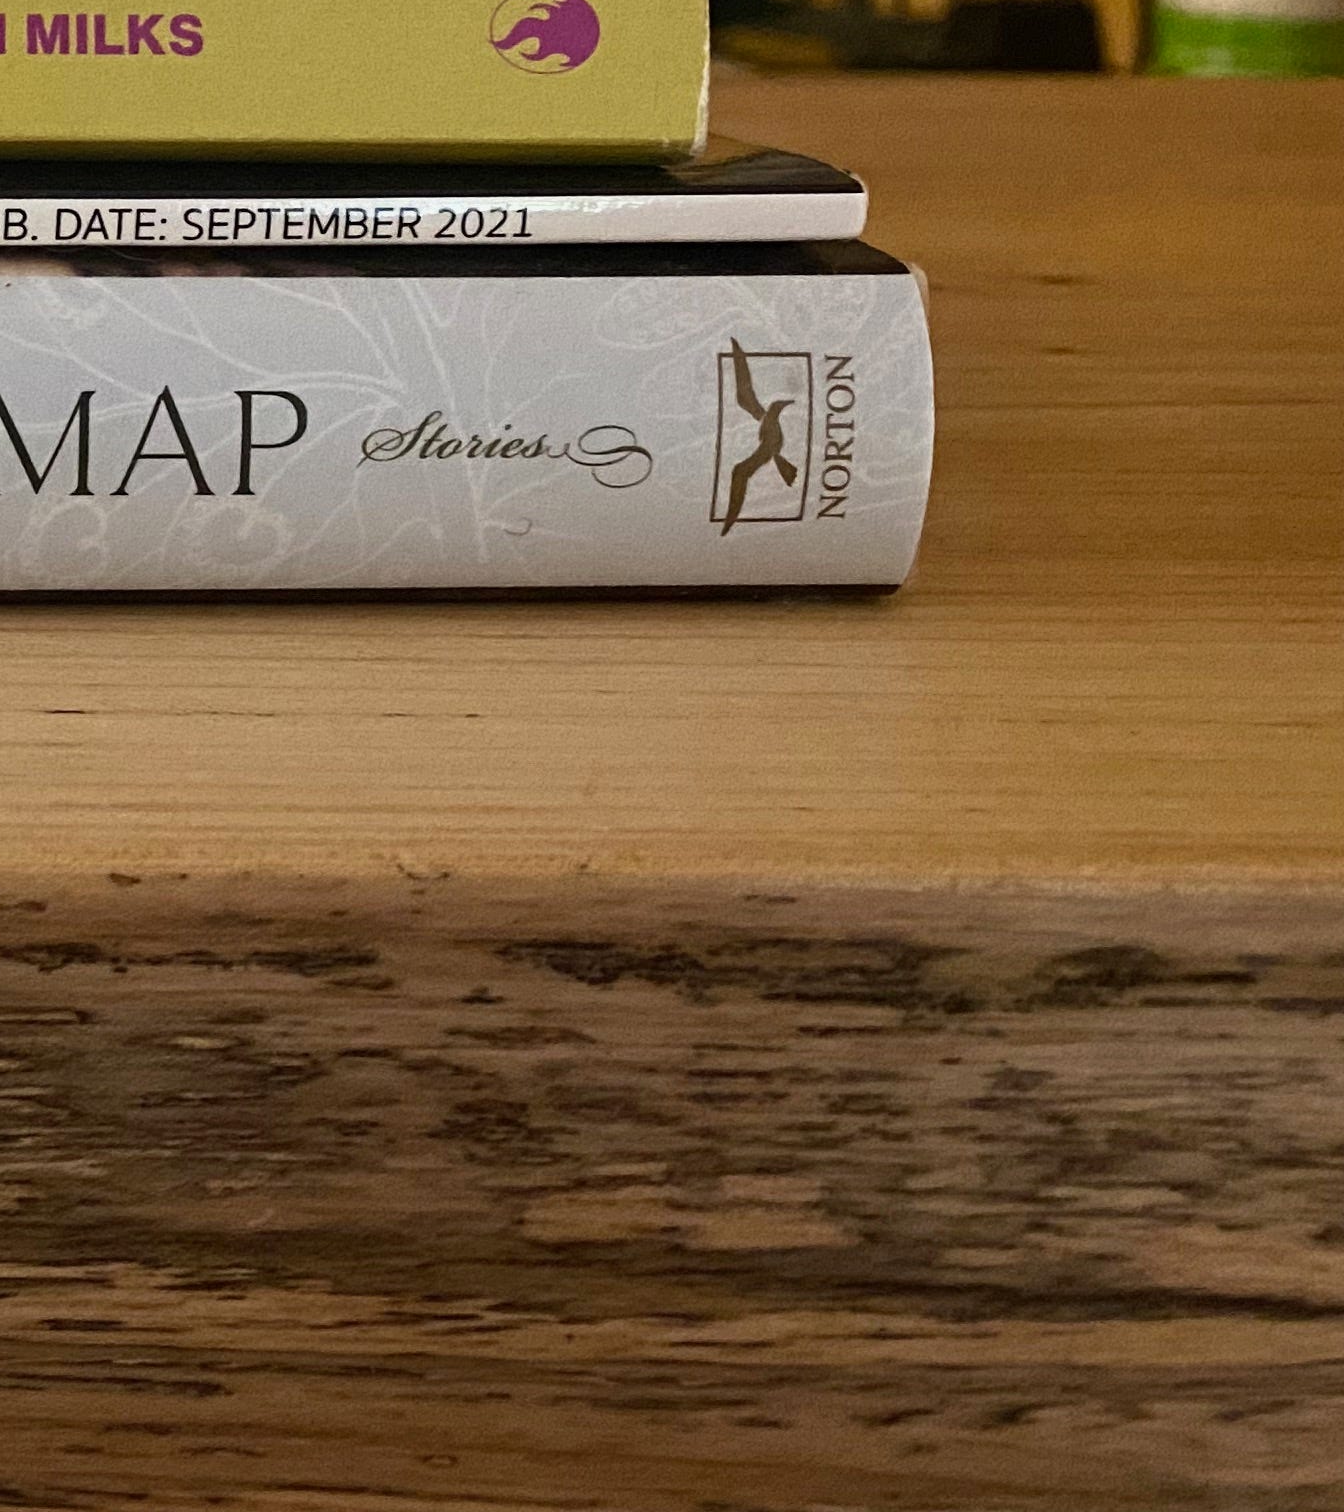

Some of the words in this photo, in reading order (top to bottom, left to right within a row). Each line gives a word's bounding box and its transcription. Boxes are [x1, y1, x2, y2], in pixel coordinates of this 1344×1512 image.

[26, 13, 204, 57] MILKS
[54, 207, 168, 241] DATE:
[182, 207, 423, 241] SEPTEMBER
[435, 207, 534, 239] 2021
[356, 410, 654, 489] Stories
[815, 354, 856, 520] NORTON
